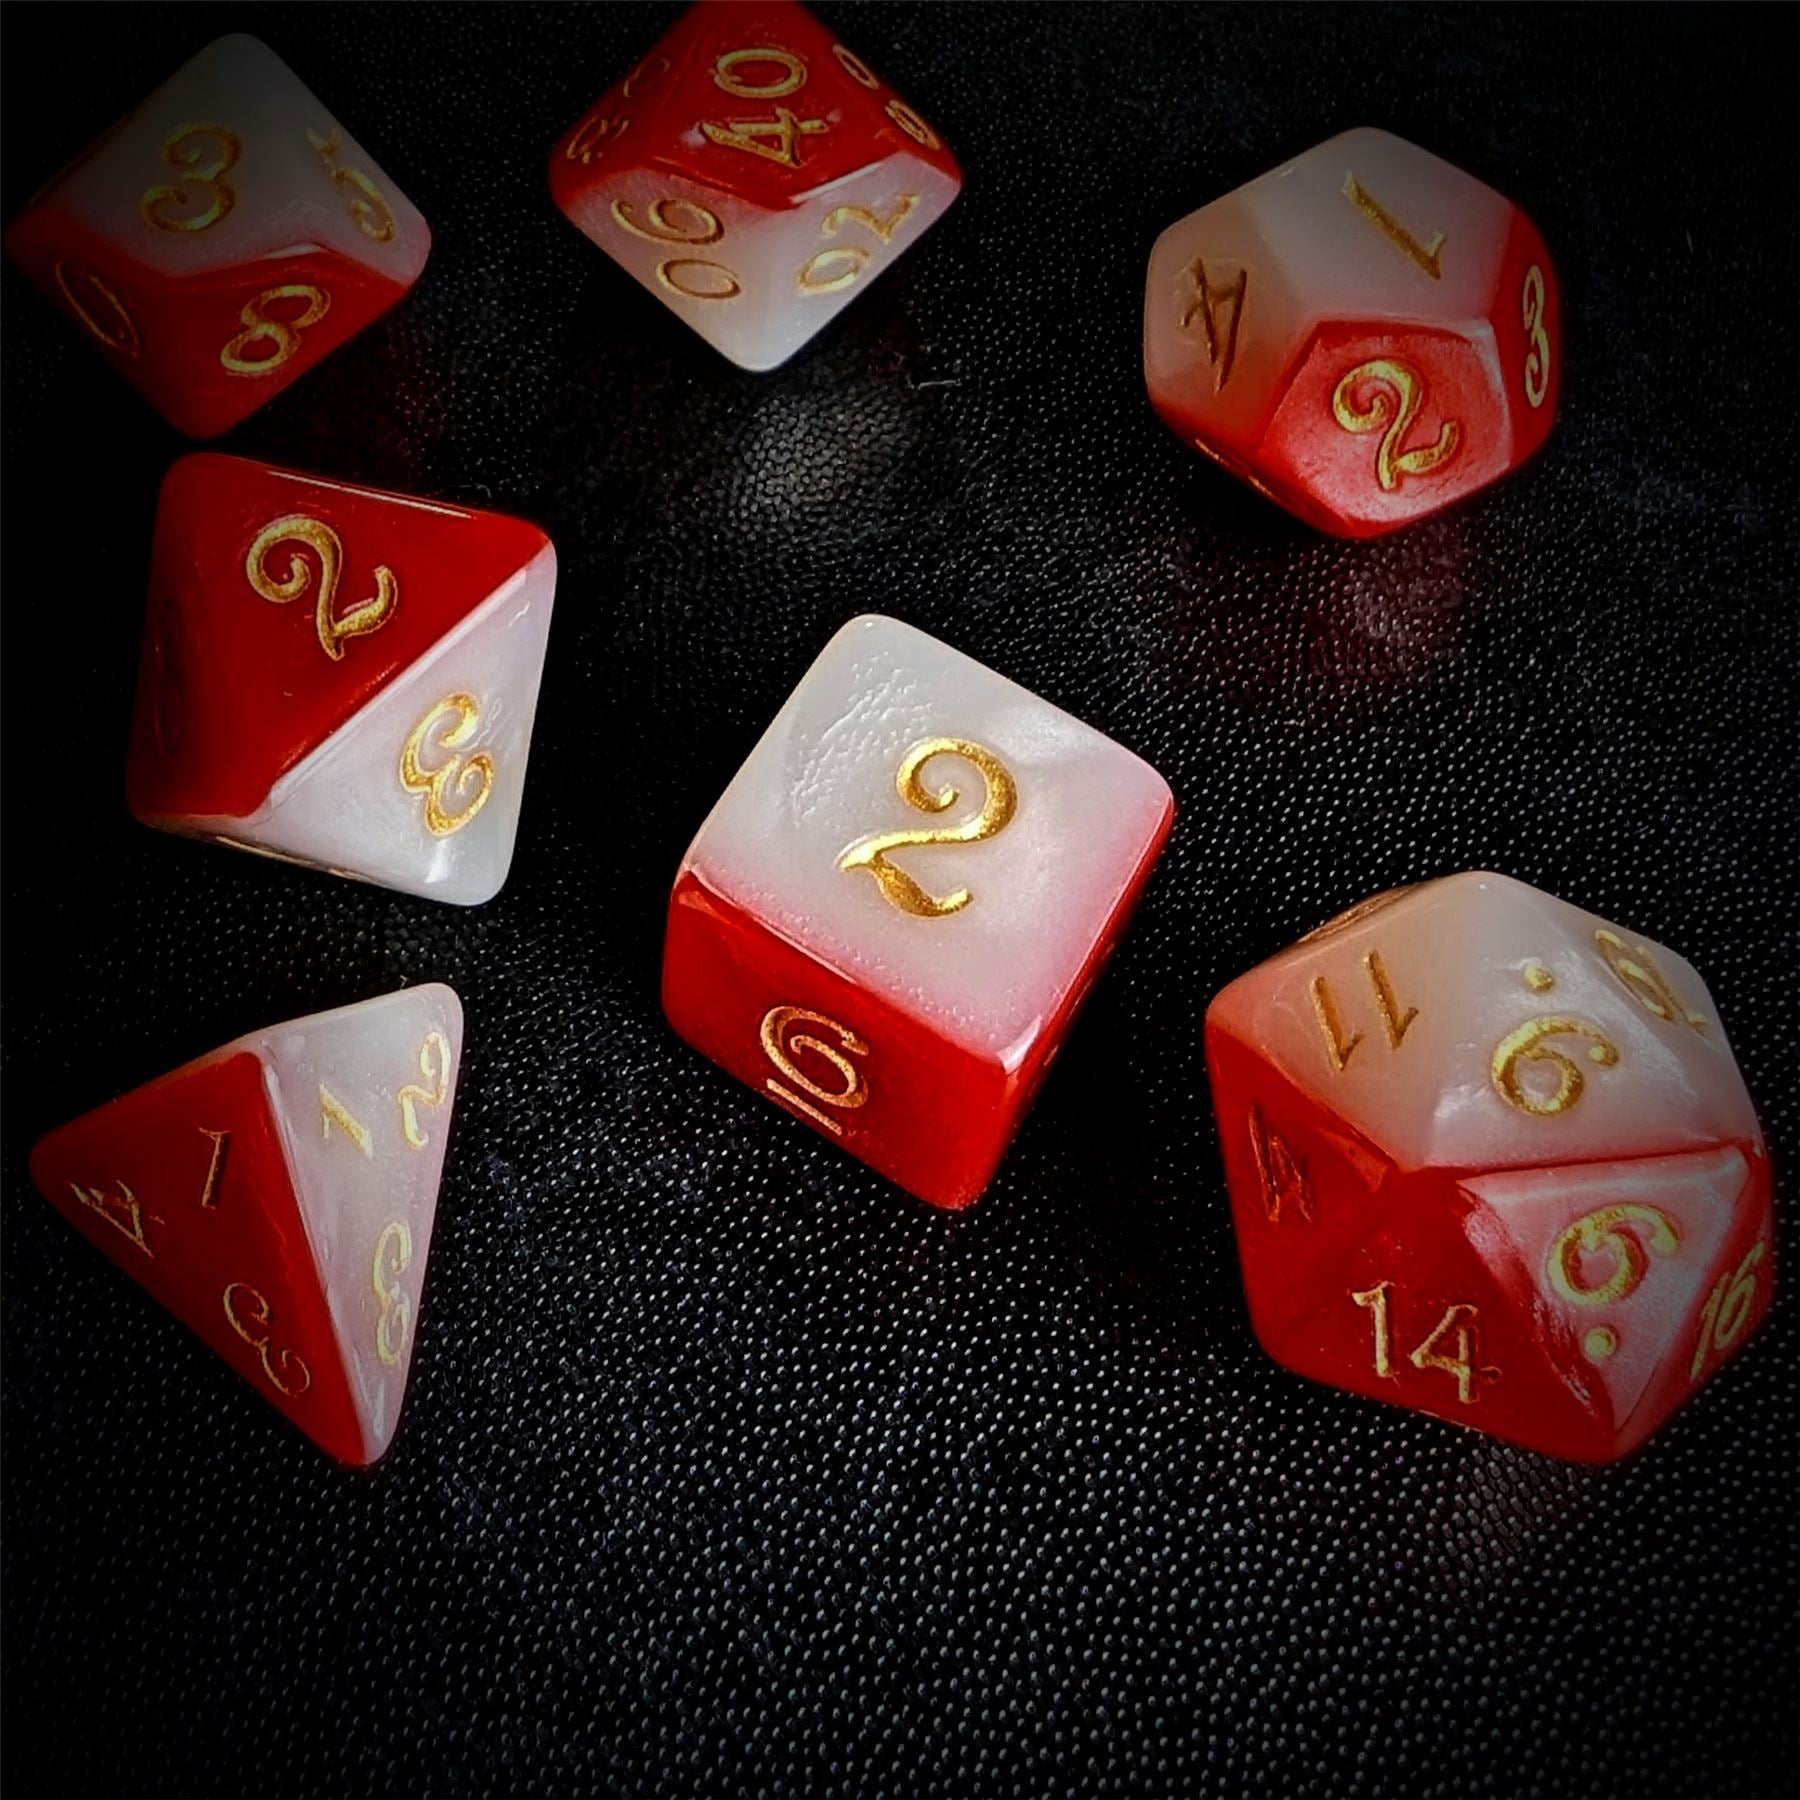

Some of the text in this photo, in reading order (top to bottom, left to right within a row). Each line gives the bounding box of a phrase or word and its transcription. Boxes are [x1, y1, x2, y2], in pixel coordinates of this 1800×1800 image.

[141, 122, 242, 233] 3
[1342, 170, 1446, 279] 1
[219, 283, 332, 376] 8
[1180, 258, 1248, 395] 4
[1332, 358, 1464, 492] 2
[245, 513, 399, 662] 2
[400, 692, 494, 836] 3
[836, 736, 1018, 917] 2
[759, 1005, 870, 1136] 6
[1309, 950, 1420, 1072] 11
[318, 1084, 374, 1158] 1
[399, 1032, 452, 1150] 2
[197, 1126, 231, 1210] 1
[222, 1281, 312, 1399] 3
[373, 1221, 413, 1366] 3
[1352, 1279, 1504, 1405] 14
